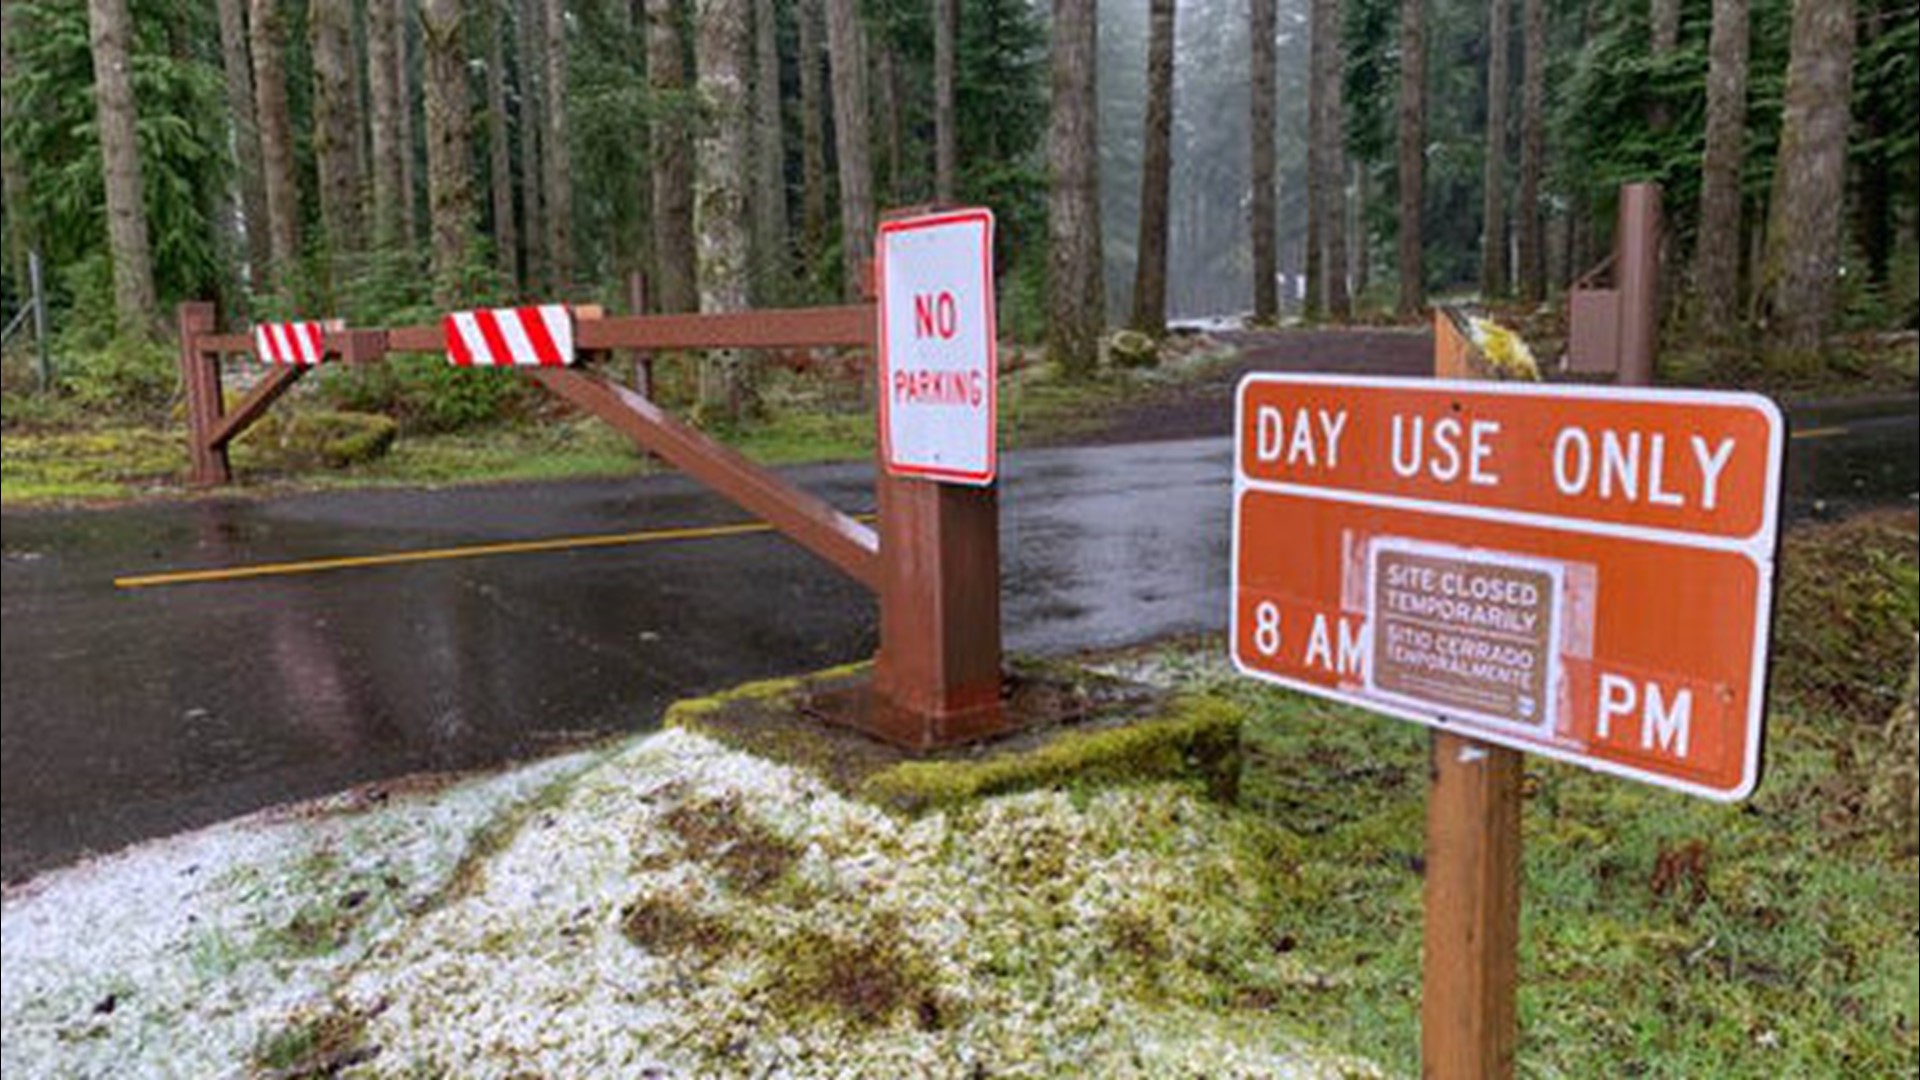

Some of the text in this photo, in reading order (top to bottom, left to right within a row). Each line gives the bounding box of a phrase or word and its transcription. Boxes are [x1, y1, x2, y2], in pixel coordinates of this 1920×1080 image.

[914, 291, 956, 339] NO
[894, 369, 982, 407] PARKING
[1256, 406, 1736, 510] DAY USE ONLY
[1386, 563, 1538, 606] SITE CLOSED
[1387, 590, 1537, 632] TEMPORARILY
[1254, 601, 1367, 680] 8 AM
[1386, 622, 1534, 669] SITIO CERRADO
[1387, 644, 1533, 690] TEMPORALMENTE
[1596, 673, 1693, 758] PM
